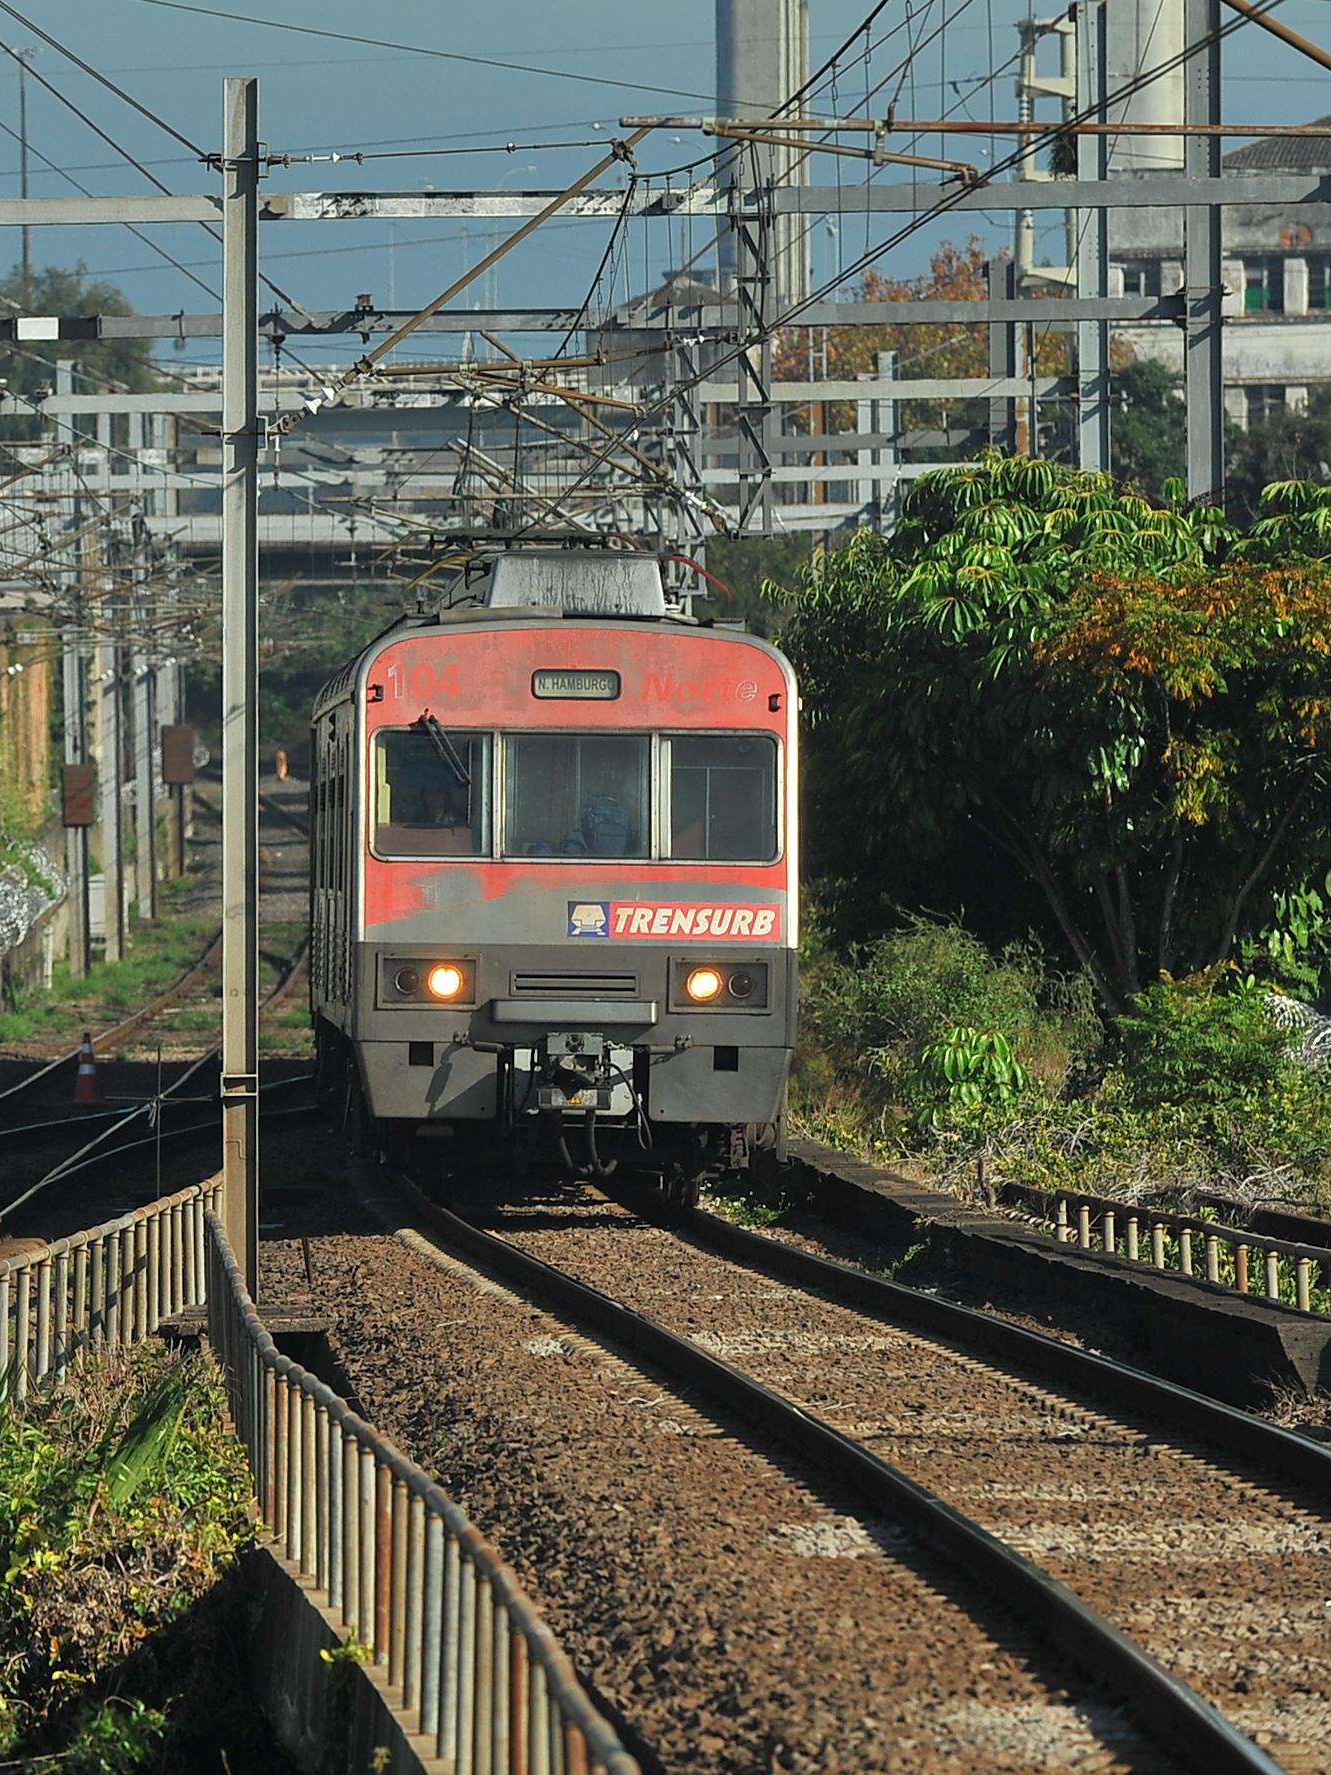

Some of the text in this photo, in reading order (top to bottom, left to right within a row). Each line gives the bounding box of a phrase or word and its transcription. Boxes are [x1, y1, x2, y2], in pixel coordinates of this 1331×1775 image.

[387, 664, 462, 699] 104
[538, 678, 615, 691] N. HAMBURGO
[641, 670, 759, 702] Norte
[614, 906, 776, 937] TRENSURB
